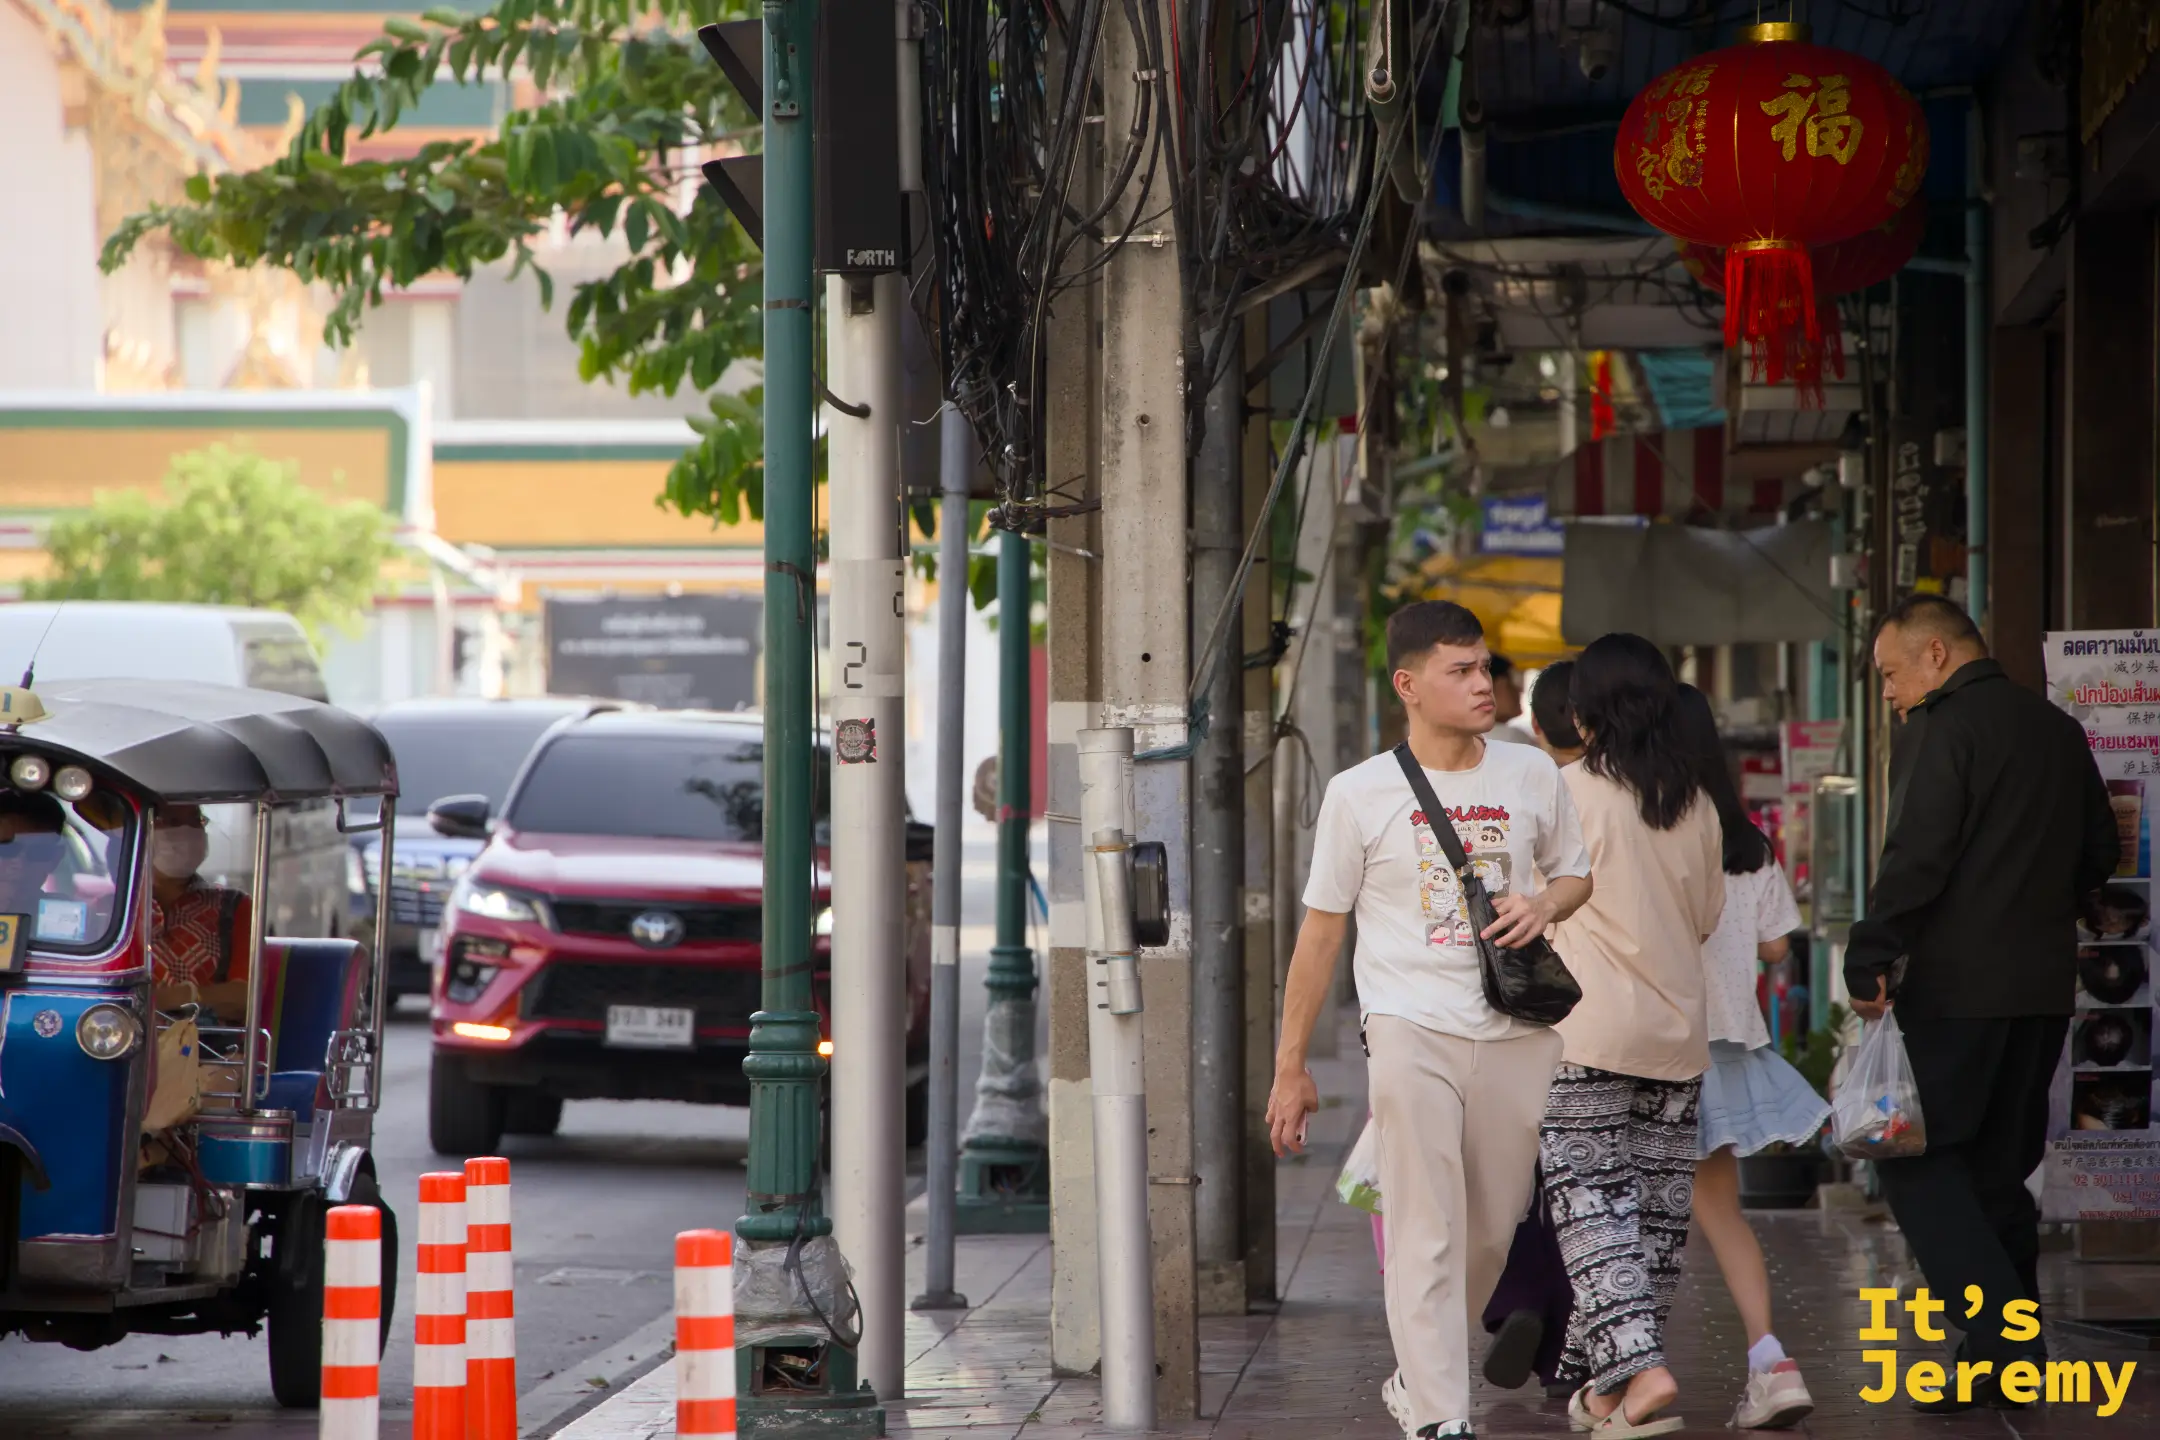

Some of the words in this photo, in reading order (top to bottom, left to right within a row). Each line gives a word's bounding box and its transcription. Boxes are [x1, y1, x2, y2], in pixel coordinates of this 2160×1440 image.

[1759, 73, 1864, 165] 福
[844, 641, 866, 688] 2
[2126, 711, 2160, 725] 保护
